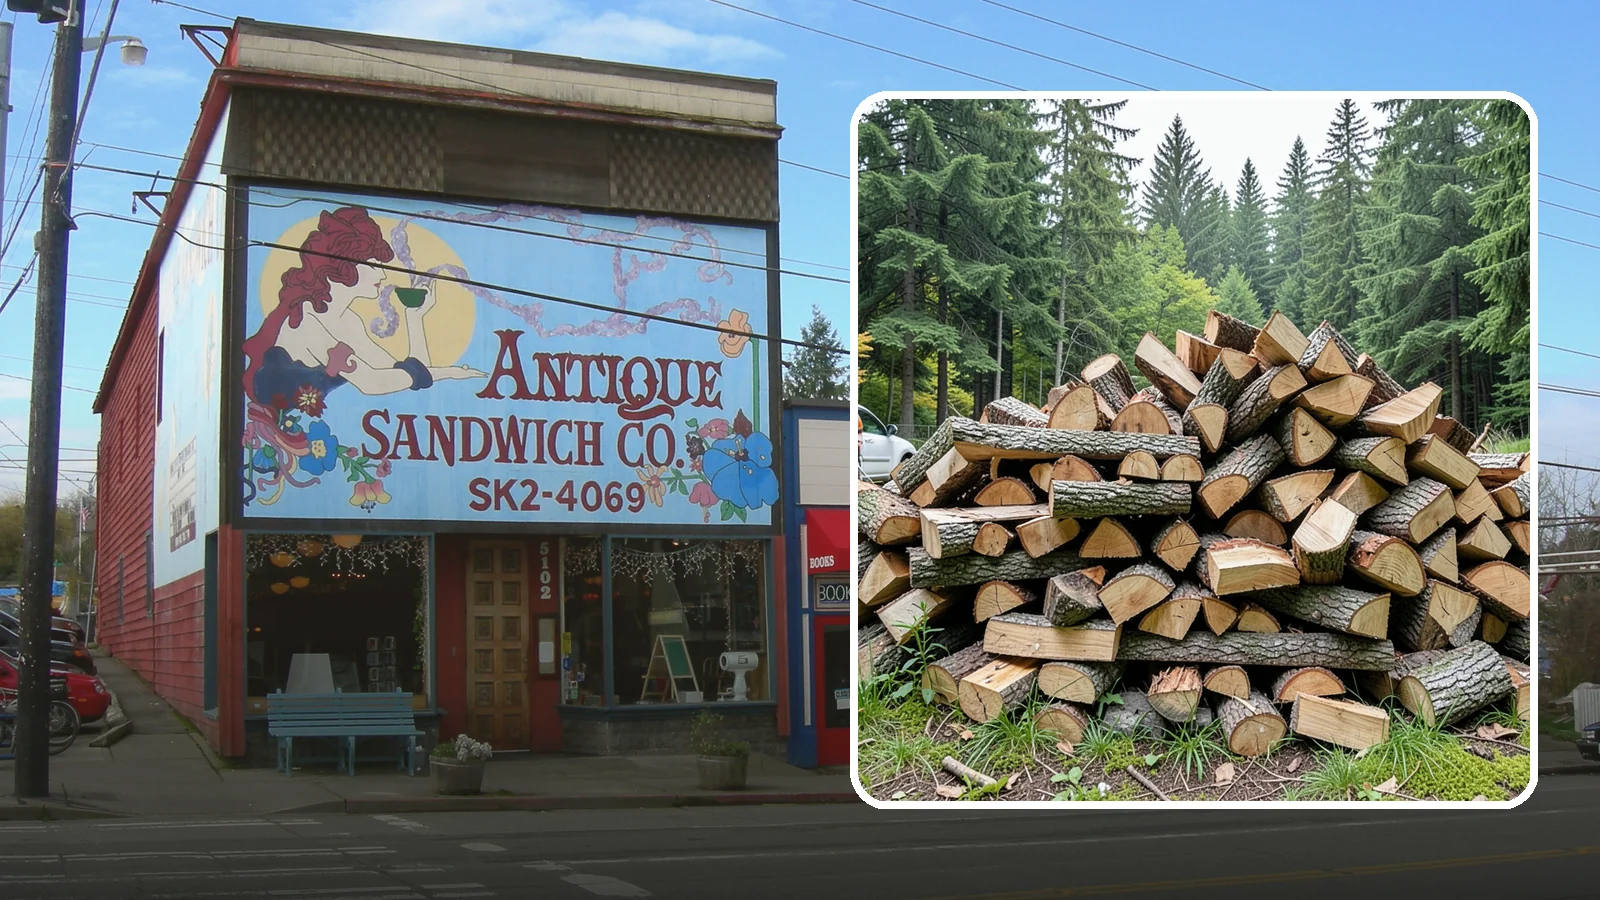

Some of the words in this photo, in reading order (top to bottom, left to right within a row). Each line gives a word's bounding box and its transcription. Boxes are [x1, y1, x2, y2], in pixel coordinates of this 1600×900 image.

[476, 329, 723, 421] ANTIQUE
[361, 408, 604, 467] SANDWICH
[617, 422, 685, 469] CO.
[468, 476, 646, 513] SK2-4069
[809, 555, 835, 569] BOOKS
